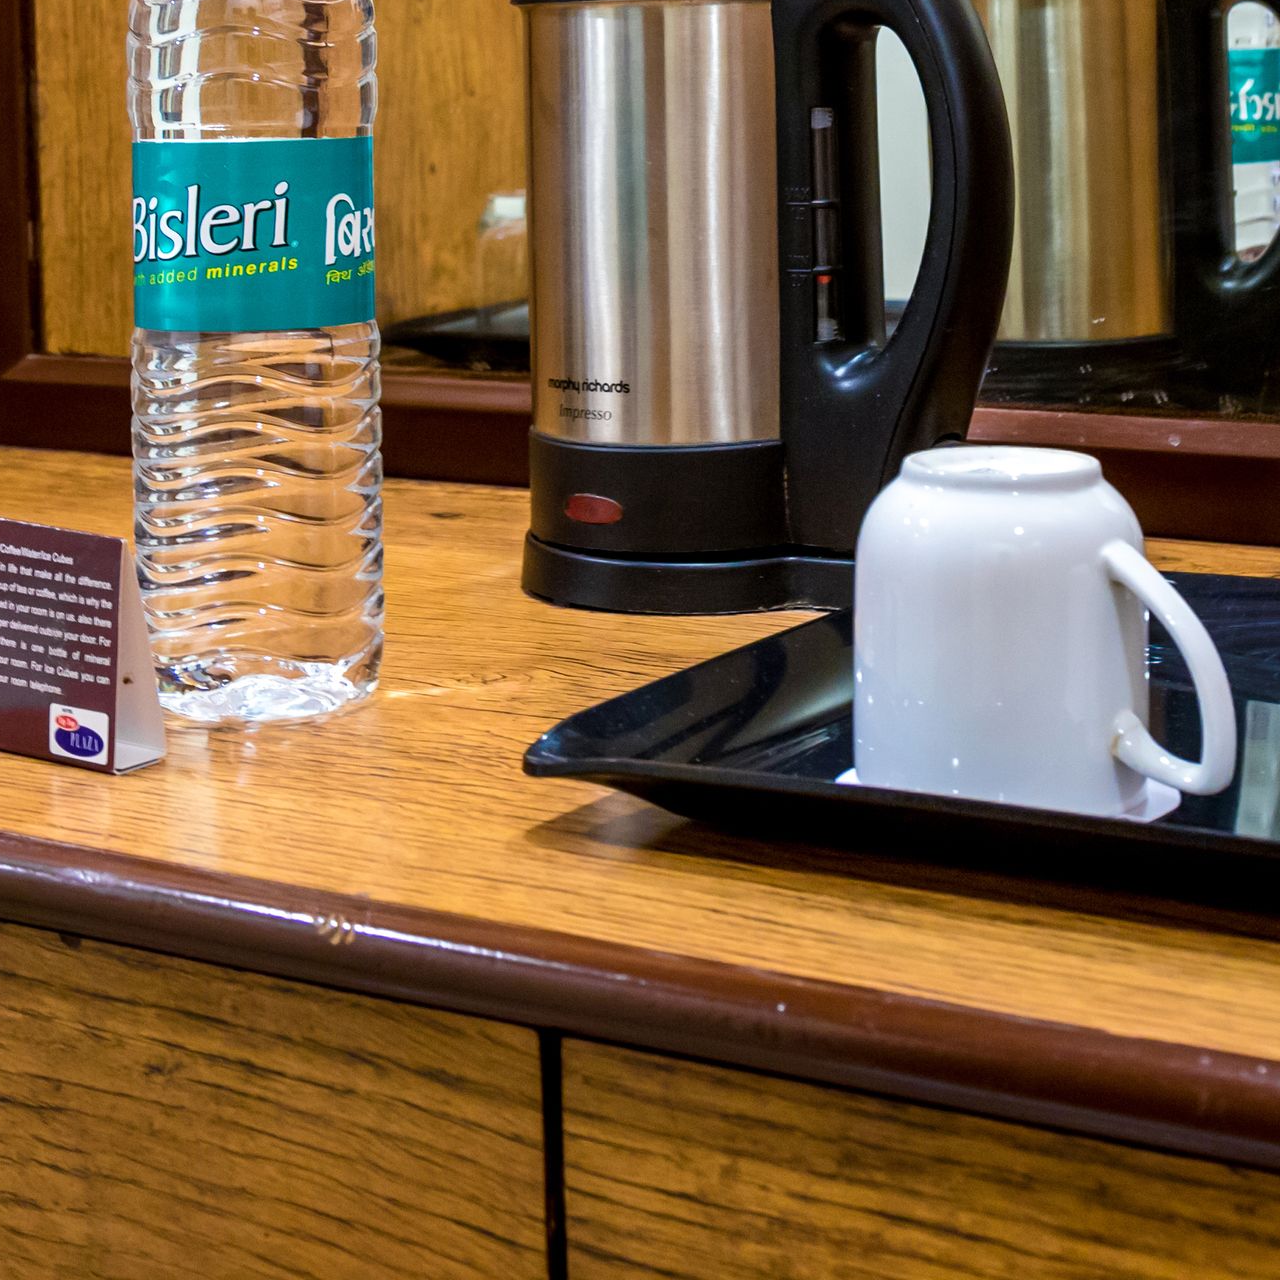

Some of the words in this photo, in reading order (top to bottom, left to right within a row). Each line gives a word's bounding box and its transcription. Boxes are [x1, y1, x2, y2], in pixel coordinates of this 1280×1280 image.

[133, 181, 289, 263] Bisleri
[150, 267, 198, 285] added
[207, 257, 298, 279] minerals
[548, 377, 580, 394] morphy
[582, 378, 631, 393] richards
[52, 552, 74, 565] Cubes
[0, 562, 6, 572] in
[8, 563, 18, 574] life
[20, 566, 33, 576] that
[34, 569, 53, 580] make
[54, 572, 63, 582] all
[65, 574, 76, 584] the
[9, 582, 16, 592] of
[28, 587, 35, 596] or
[59, 593, 78, 603] which
[79, 594, 85, 605] is
[86, 597, 100, 610] why
[101, 599, 113, 610] the
[9, 601, 15, 610] in
[16, 604, 30, 614] your
[31, 606, 48, 617] room
[49, 608, 55, 618] is
[56, 611, 65, 620] on
[78, 614, 93, 625] also
[94, 617, 112, 628] there
[9, 620, 39, 634] delivered
[64, 632, 80, 641] your
[99, 636, 112, 647] For
[0, 636, 17, 648] there
[21, 640, 28, 650] is
[31, 644, 45, 654] one
[49, 646, 68, 659] bottle
[72, 650, 81, 661] of
[84, 653, 112, 666] mineral
[10, 677, 28, 687] room
[31, 661, 43, 672] For
[57, 666, 79, 679] Cubes
[81, 672, 95, 683] you
[96, 675, 111, 685] can
